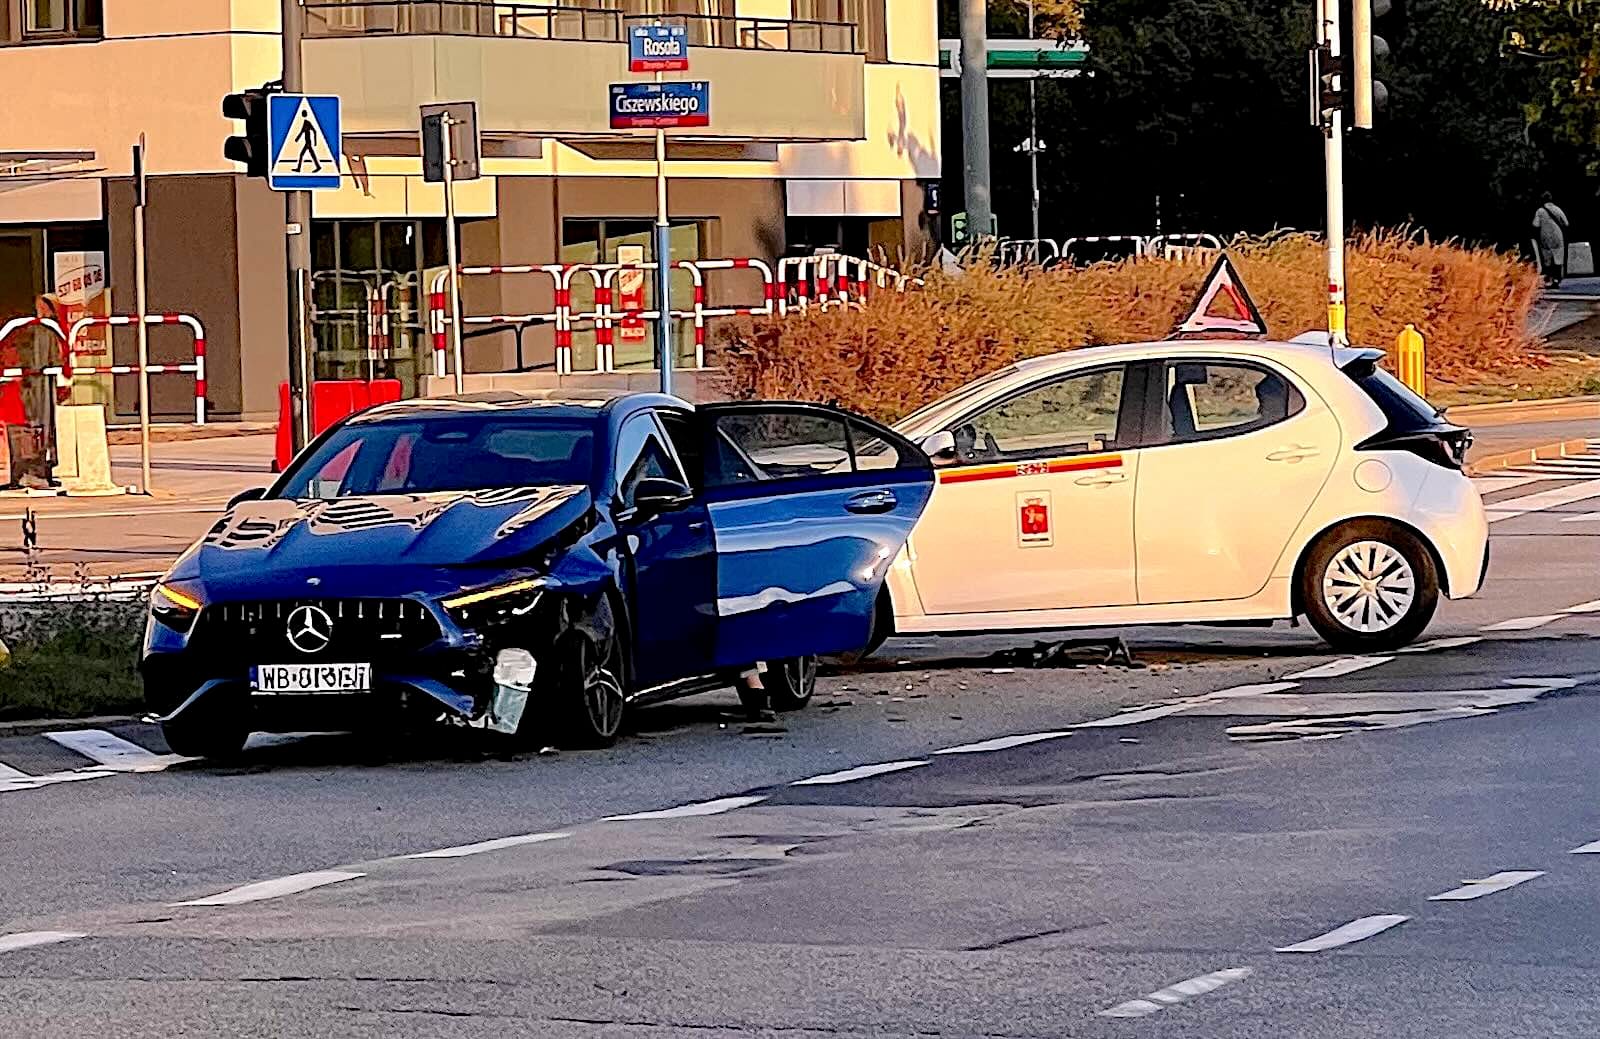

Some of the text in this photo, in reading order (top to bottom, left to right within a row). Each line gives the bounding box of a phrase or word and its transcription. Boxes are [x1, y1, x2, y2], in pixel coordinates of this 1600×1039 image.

[644, 36, 681, 56] Rosoła
[616, 92, 698, 116] Ciszewskiego
[262, 667, 290, 690] WB
